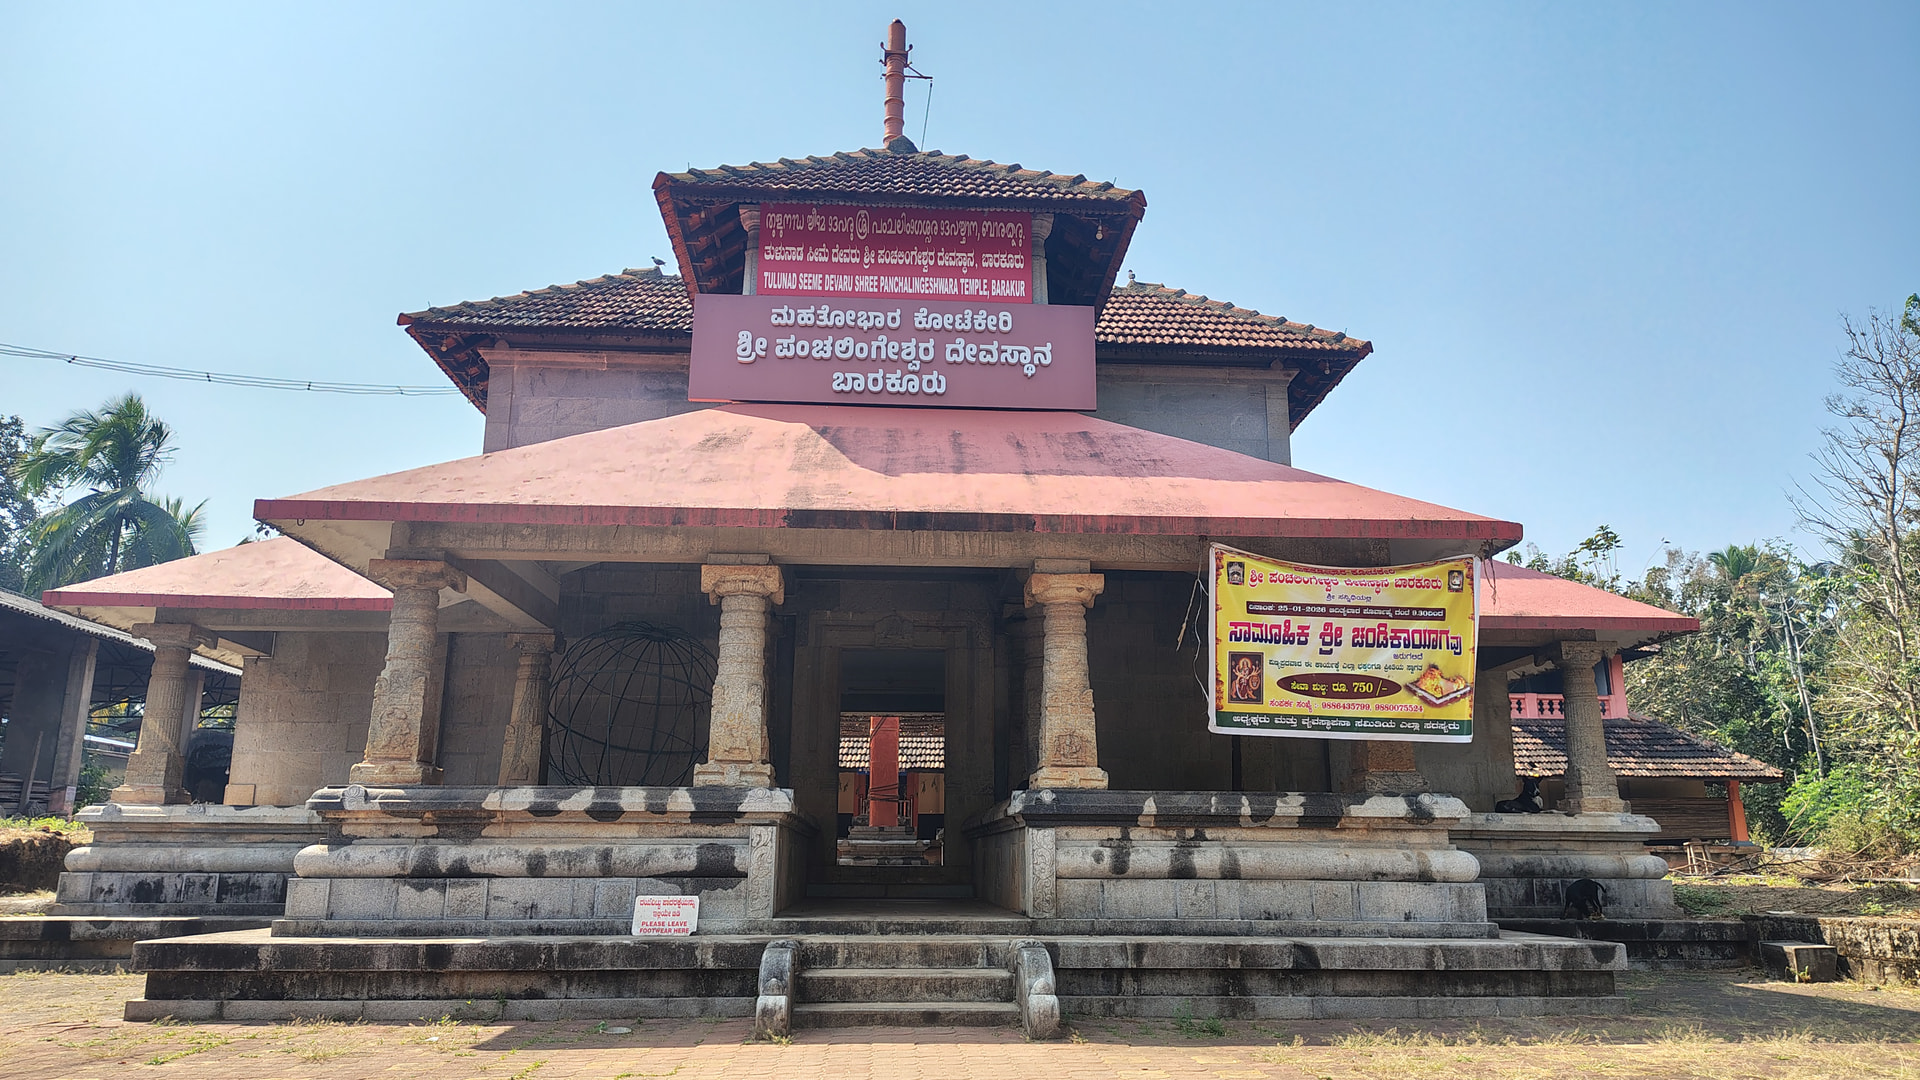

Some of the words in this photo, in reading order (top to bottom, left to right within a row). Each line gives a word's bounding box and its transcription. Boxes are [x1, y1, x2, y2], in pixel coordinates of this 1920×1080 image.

[831, 244, 860, 264] ದೇವರು
[863, 245, 875, 269] ಶ್ರೀ
[982, 248, 1025, 269] ಬಾರಕೂರು
[763, 271, 797, 289] TULUNAD
[798, 273, 823, 291] SEEME
[824, 274, 853, 292] DEVARU
[854, 275, 878, 293] SHREE
[879, 276, 958, 295] PANCHALINGESHWARA
[960, 278, 990, 299] TEMPLE,
[991, 279, 1025, 297] BARAKUR
[770, 304, 901, 332] ಮಹತೋಭಾರ
[913, 307, 1013, 333] ಕೋಟೆಕೇರಿ
[736, 330, 768, 364] ಶ್ರೀ
[774, 333, 935, 372] ಪಂಚಲಿಂಗೇಶ್ವರ
[945, 337, 1052, 378] ದೇವಸ್ಥಾನ
[832, 368, 947, 395] ಬಾರಕೂರು
[1249, 569, 1264, 587] ಶ್ರೀ
[1394, 575, 1442, 589] ಬಾರಕೂರು
[1277, 605, 1326, 613] 25-01-2026
[1229, 619, 1311, 646] ಸಾಮೂಹಿಕ
[1318, 621, 1343, 655] ಶ್ರೀ
[1351, 622, 1462, 656] ಚಂಡಿಕಾಯಾಗವು
[1352, 682, 1374, 693] 750
[1374, 703, 1423, 712] 9880075524
